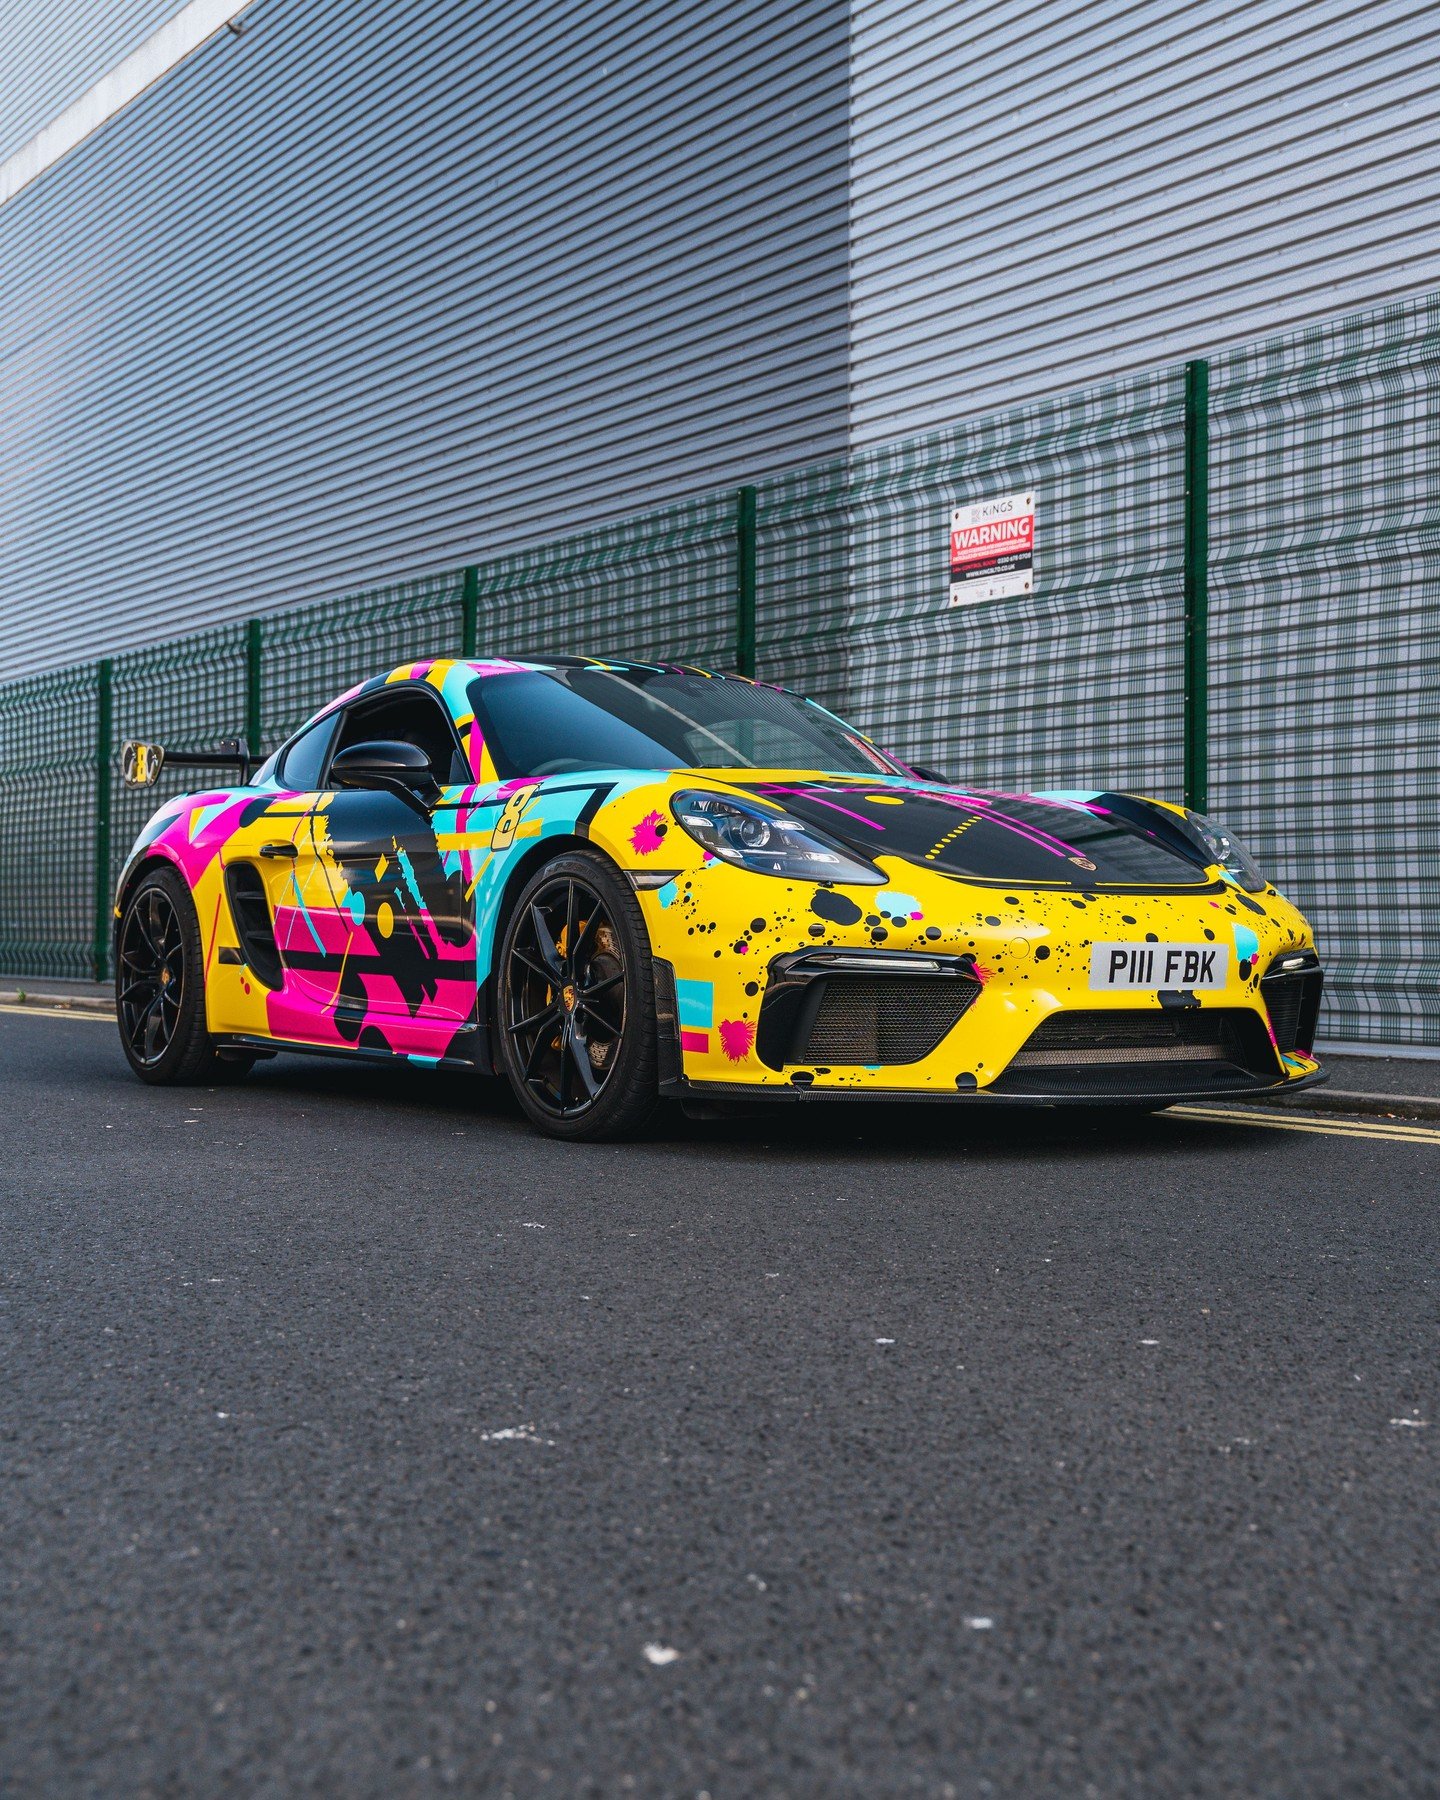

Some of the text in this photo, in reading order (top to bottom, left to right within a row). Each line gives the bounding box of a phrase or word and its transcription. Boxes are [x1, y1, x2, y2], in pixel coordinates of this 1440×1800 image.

[953, 517, 1029, 550] WARNING
[490, 783, 541, 852] 8
[1164, 950, 1216, 983] FBK
